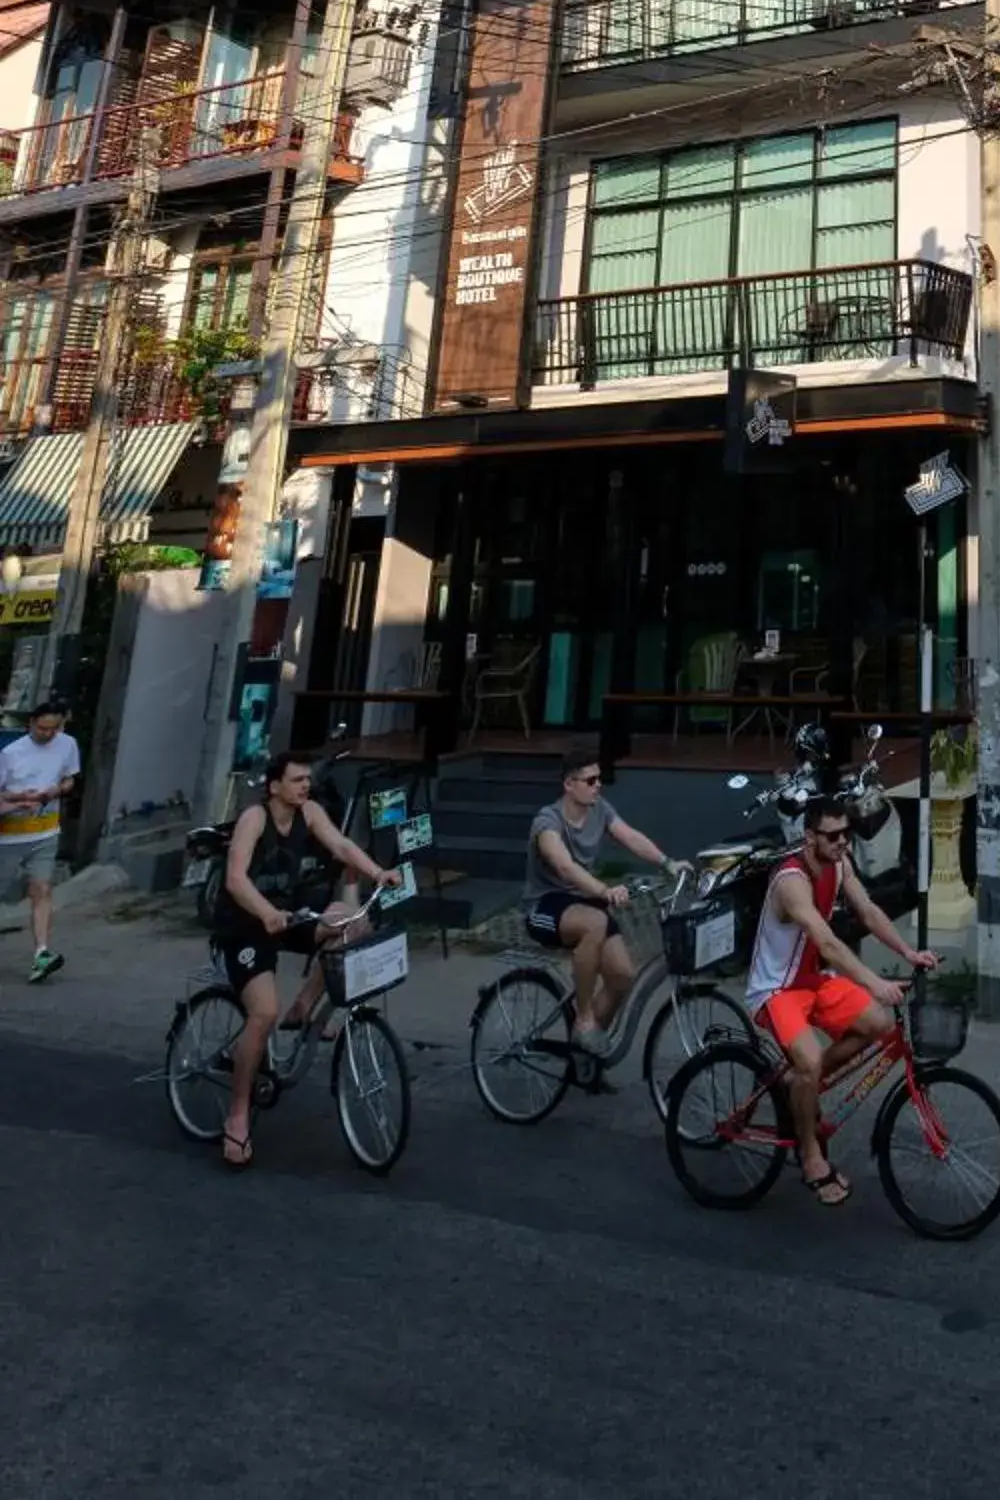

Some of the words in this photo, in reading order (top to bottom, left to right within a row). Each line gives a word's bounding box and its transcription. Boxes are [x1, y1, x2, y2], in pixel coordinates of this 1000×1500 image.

[460, 253, 513, 272] WEALTH
[457, 267, 524, 288] BOUTIQUE
[456, 287, 497, 305] HOTEL
